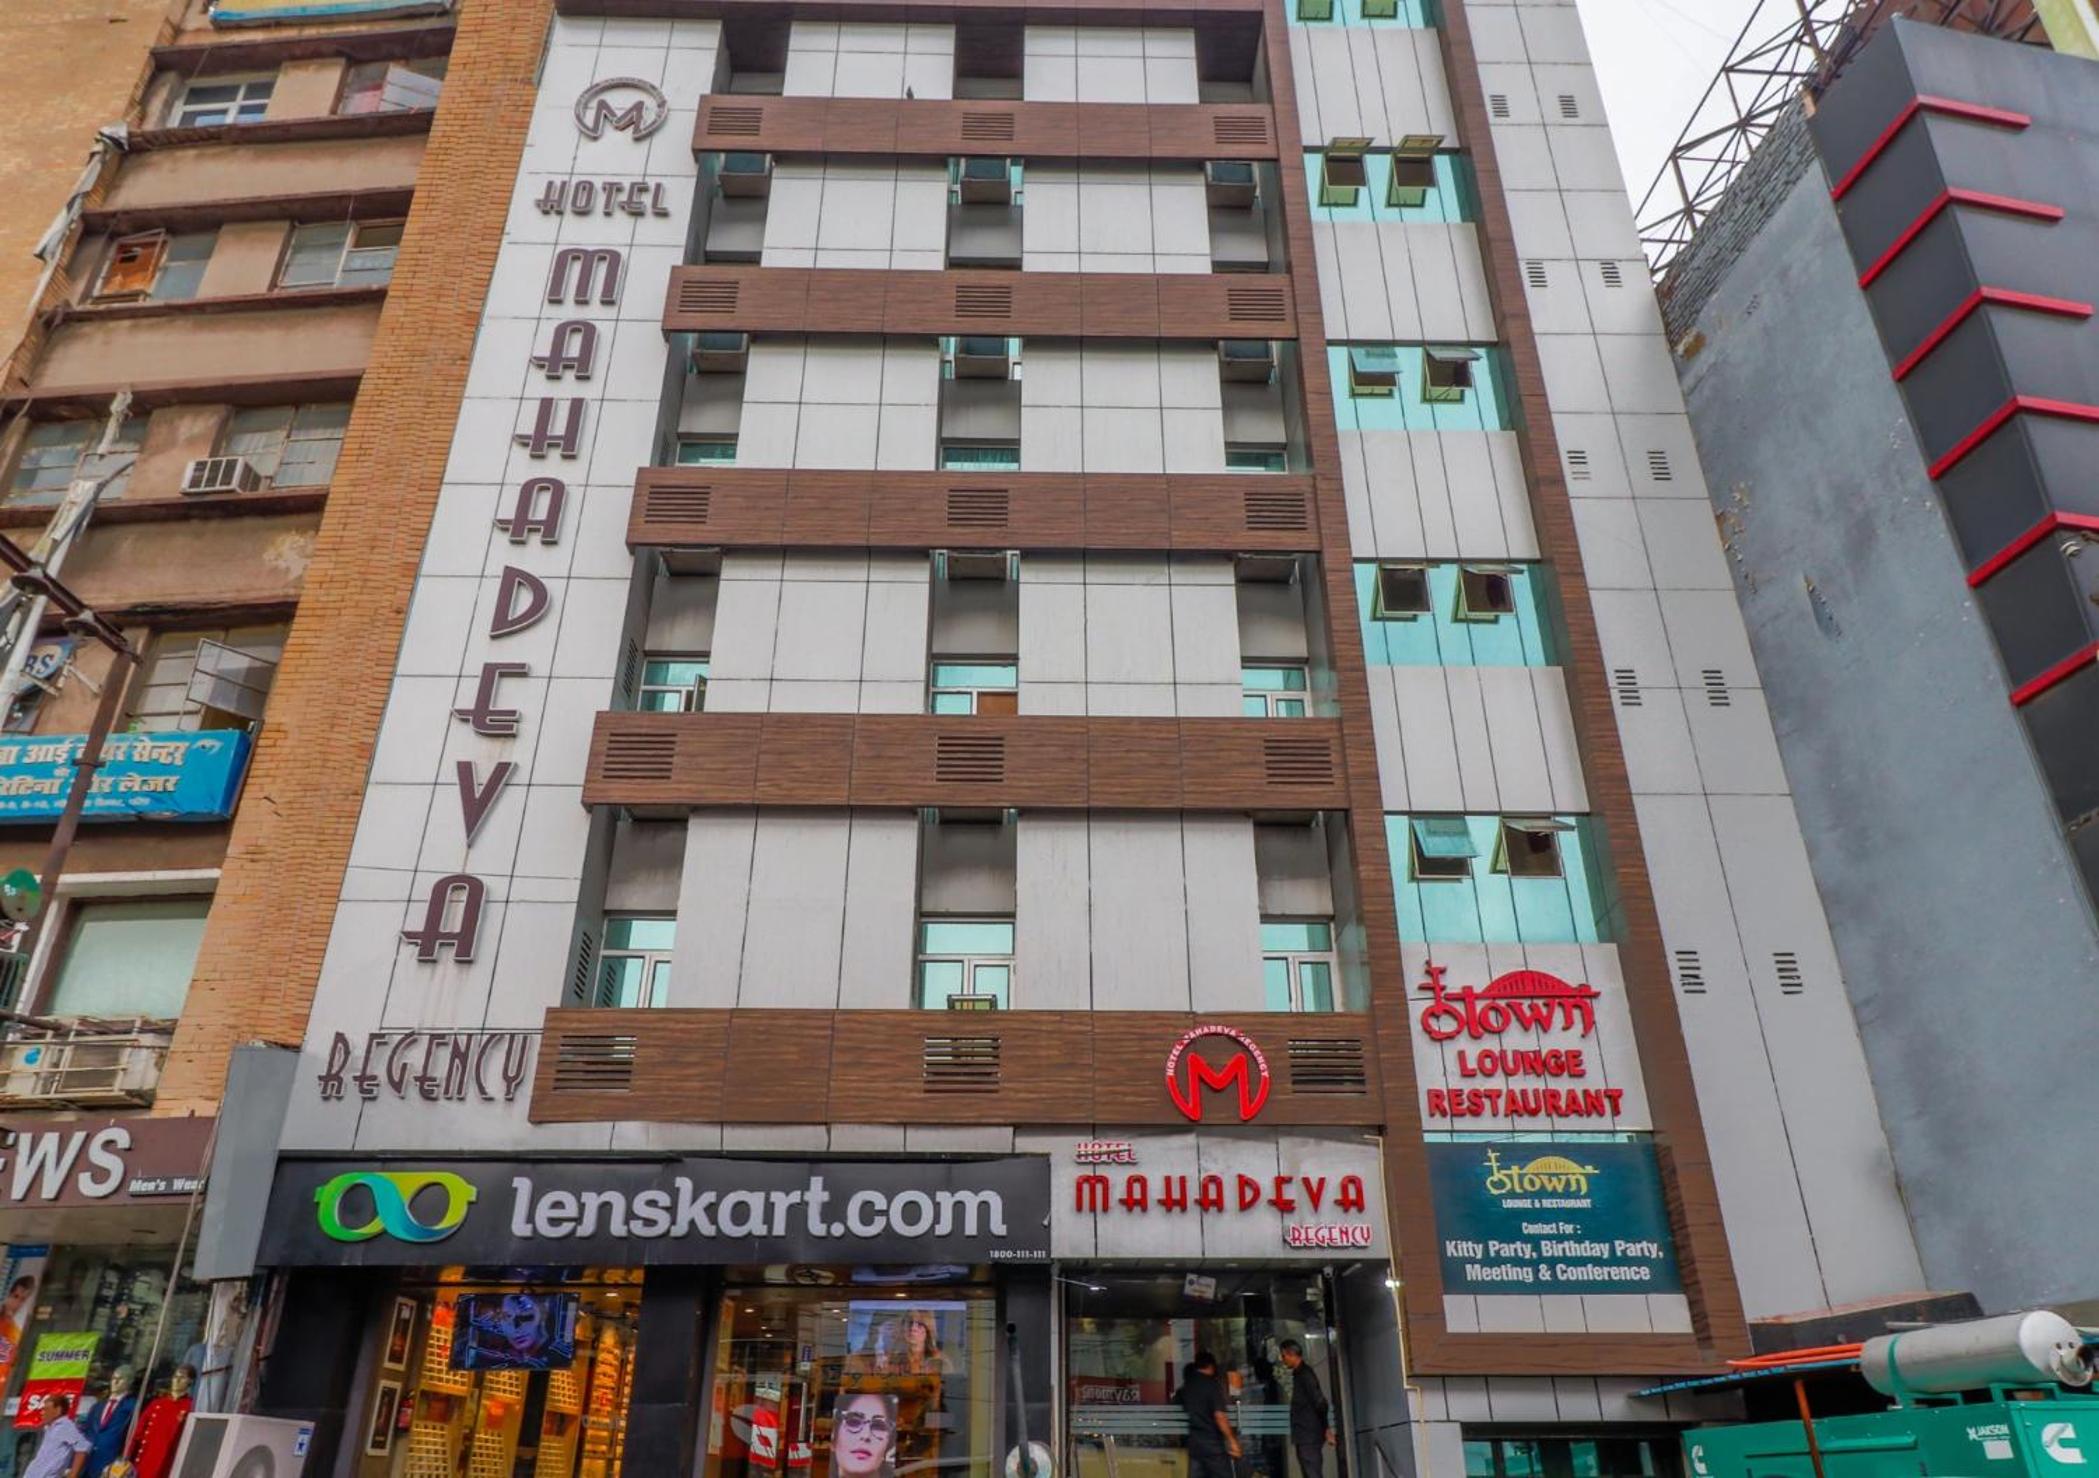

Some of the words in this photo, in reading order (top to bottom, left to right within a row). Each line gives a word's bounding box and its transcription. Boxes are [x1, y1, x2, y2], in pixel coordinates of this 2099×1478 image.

[536, 180, 669, 217] HOTEL
[318, 1032, 530, 1101] REGENCY
[1458, 1049, 1587, 1077] LOUNGE
[1427, 1089, 1623, 1117] RESTAURANT
[1074, 1139, 1138, 1164] HOTEL
[1075, 1173, 1367, 1214] MAHADEVA
[511, 1176, 1007, 1239] lenskart.com
[1288, 1224, 1372, 1248] REGENCY
[1522, 1222, 1557, 1234] Contact
[1559, 1222, 1574, 1234] For
[1446, 1240, 1482, 1259] Kitty
[1489, 1240, 1537, 1259] Party,
[1541, 1240, 1609, 1259] Birthday
[1615, 1240, 1664, 1258] Party,
[1465, 1264, 1533, 1283] Meeting
[1538, 1264, 1551, 1281] &
[1556, 1264, 1650, 1281] Conference
[39, 1350, 90, 1362] SUMMER
